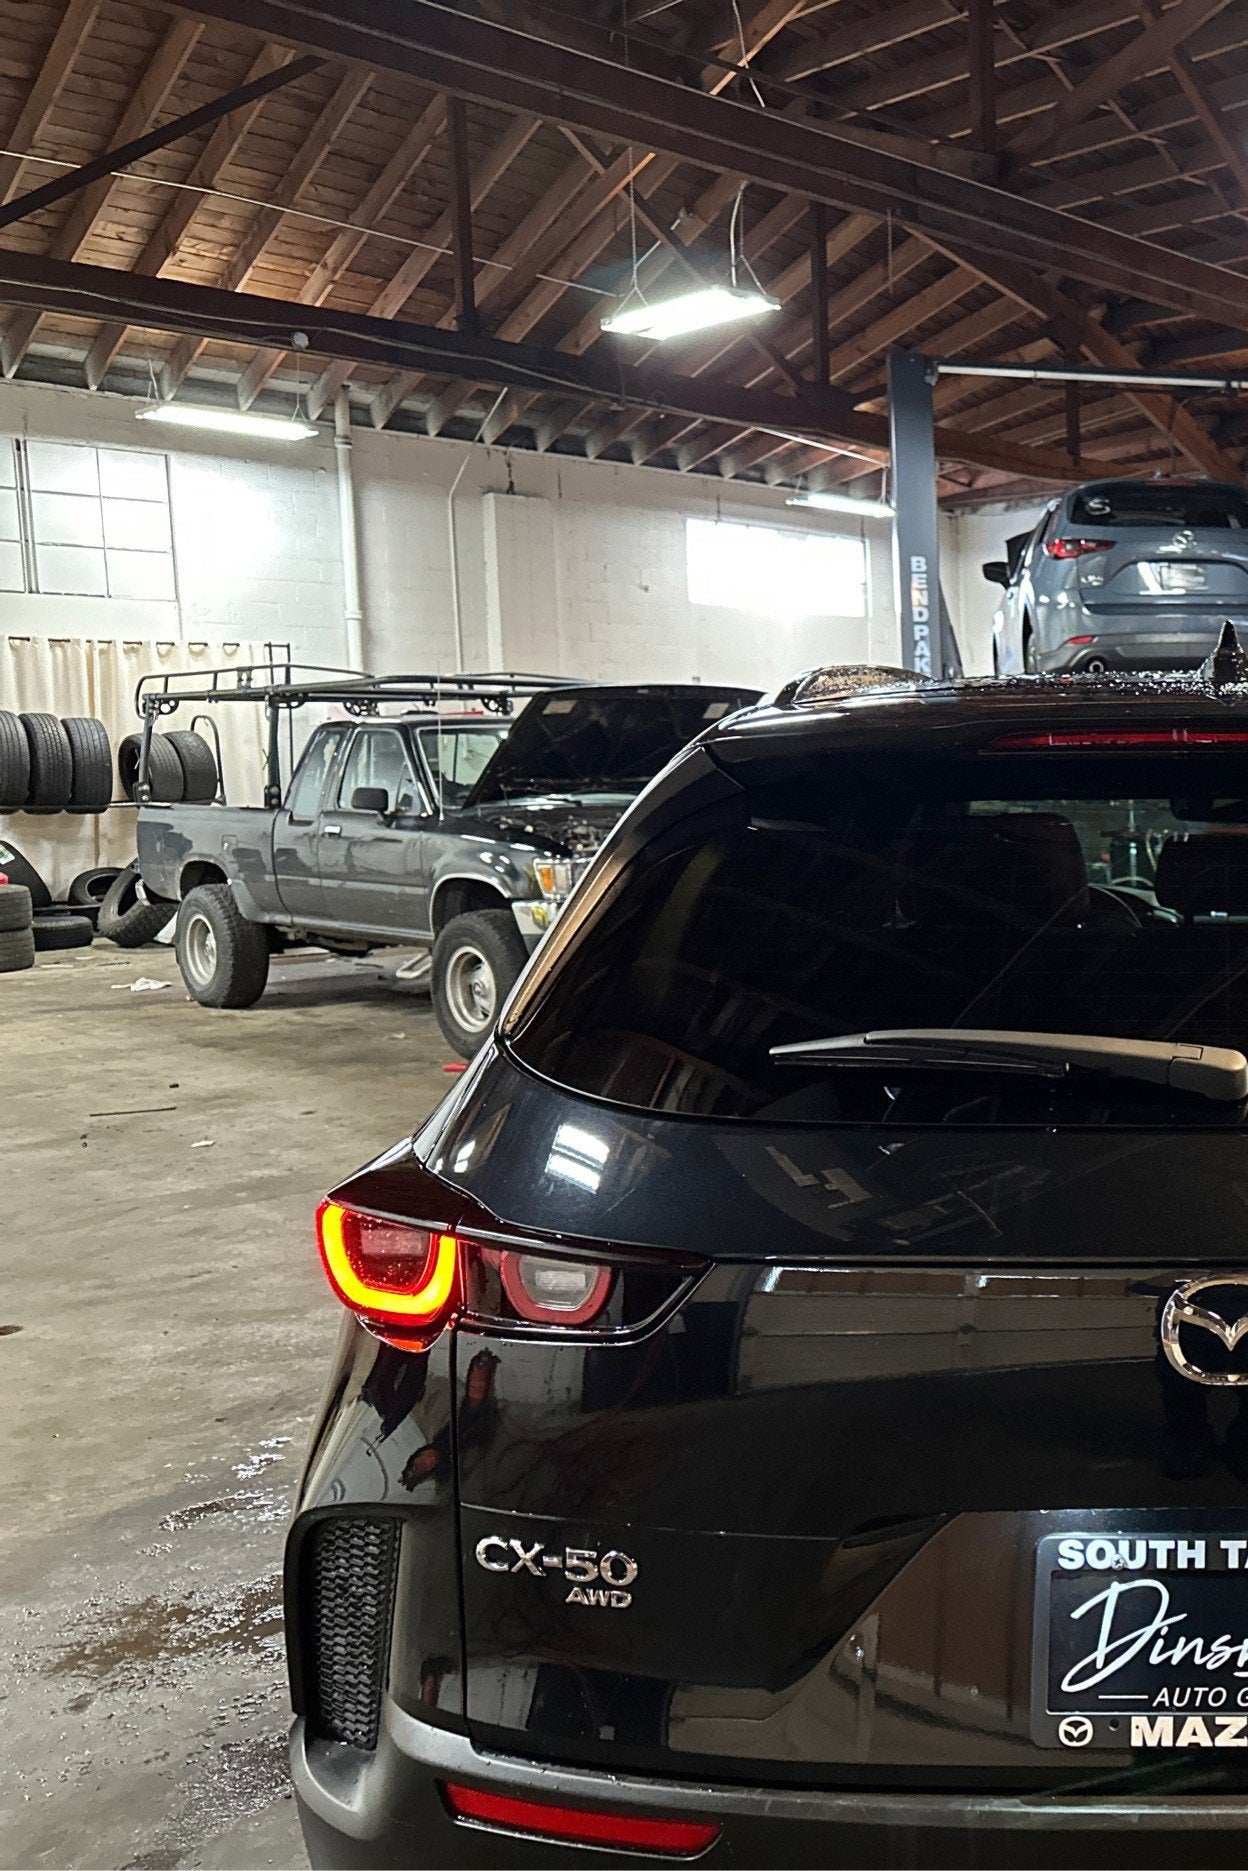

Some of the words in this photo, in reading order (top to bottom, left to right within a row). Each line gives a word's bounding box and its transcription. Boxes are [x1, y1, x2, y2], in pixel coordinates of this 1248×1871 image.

[910, 556, 931, 677] BENDPAK
[475, 1535, 638, 1586] CX-50
[1058, 1540, 1206, 1569] SOUTH
[565, 1586, 632, 1609] AWD
[1153, 1687, 1228, 1707] AUTO
